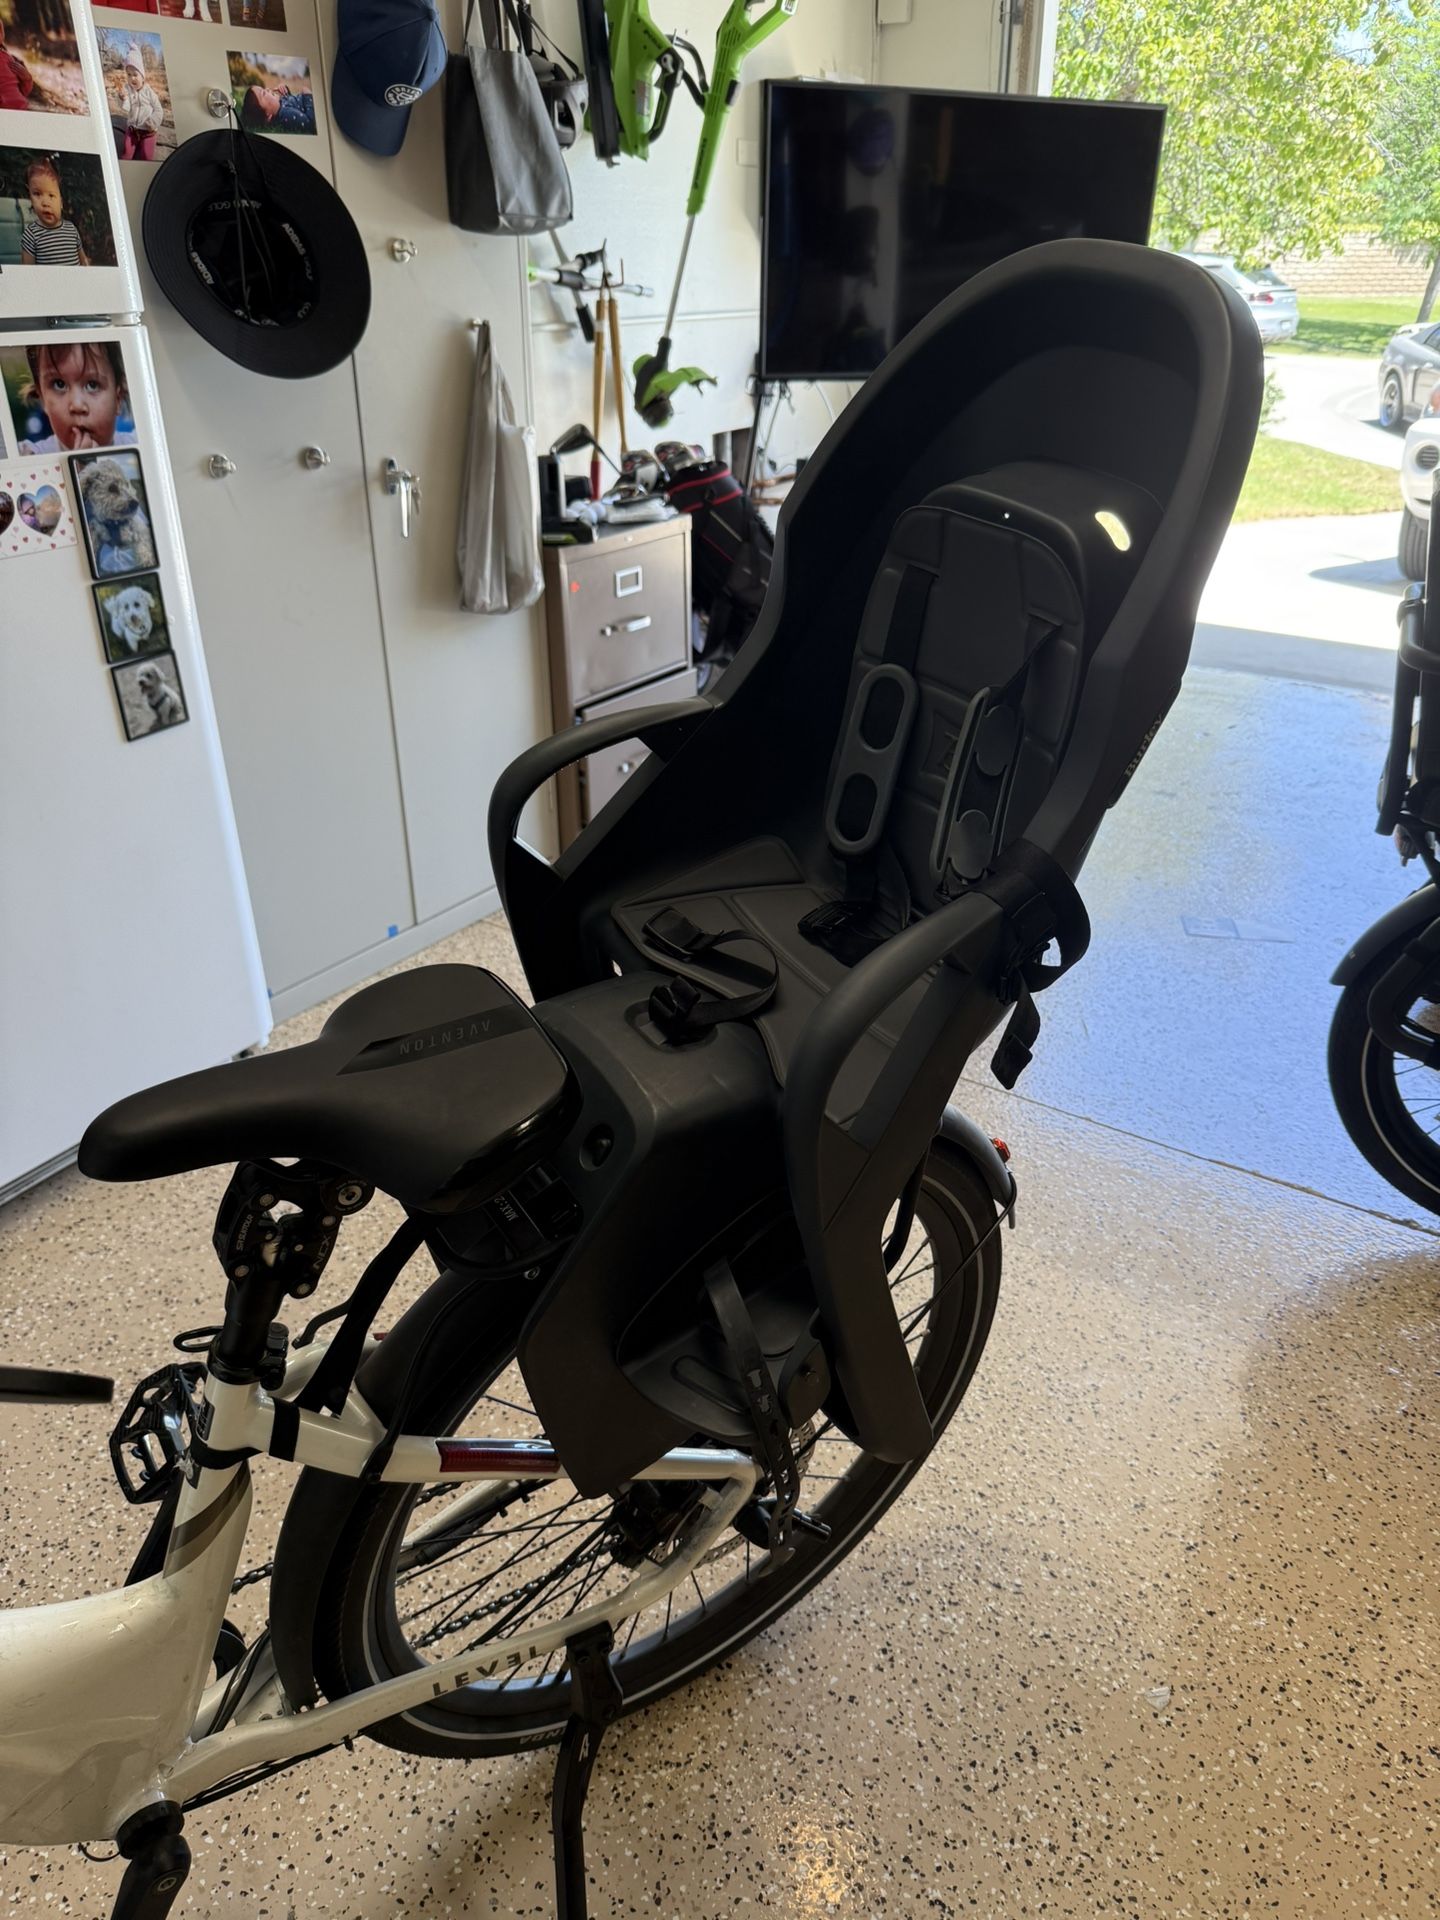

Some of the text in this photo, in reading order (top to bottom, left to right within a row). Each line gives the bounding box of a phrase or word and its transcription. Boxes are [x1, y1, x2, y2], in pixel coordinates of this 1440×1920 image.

[281, 223, 307, 256] ADIDAS
[191, 251, 215, 285] ADIDAS
[399, 1019, 491, 1055] AVENTON
